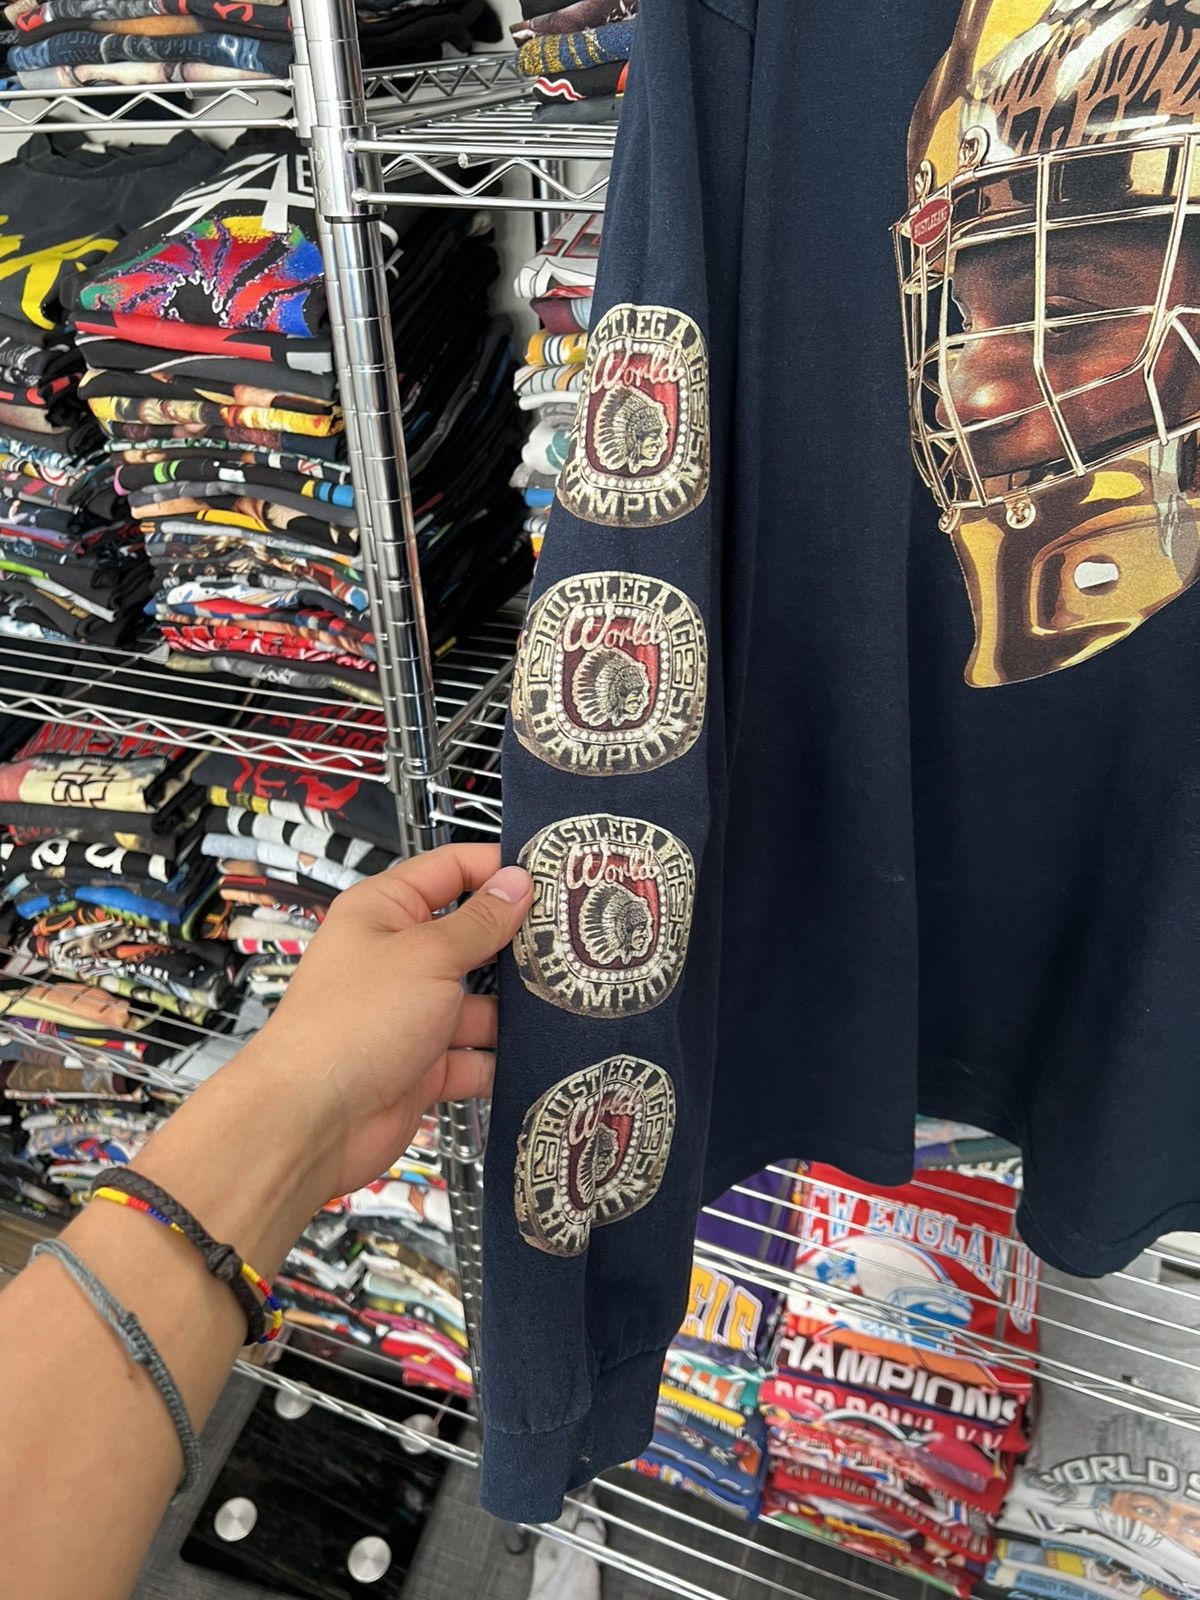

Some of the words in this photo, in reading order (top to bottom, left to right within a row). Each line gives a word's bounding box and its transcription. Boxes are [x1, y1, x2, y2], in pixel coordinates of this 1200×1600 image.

[590, 338, 684, 394] World
[562, 601, 666, 652] World
[565, 840, 660, 890] World
[866, 1194, 1041, 1335] ENGLAND
